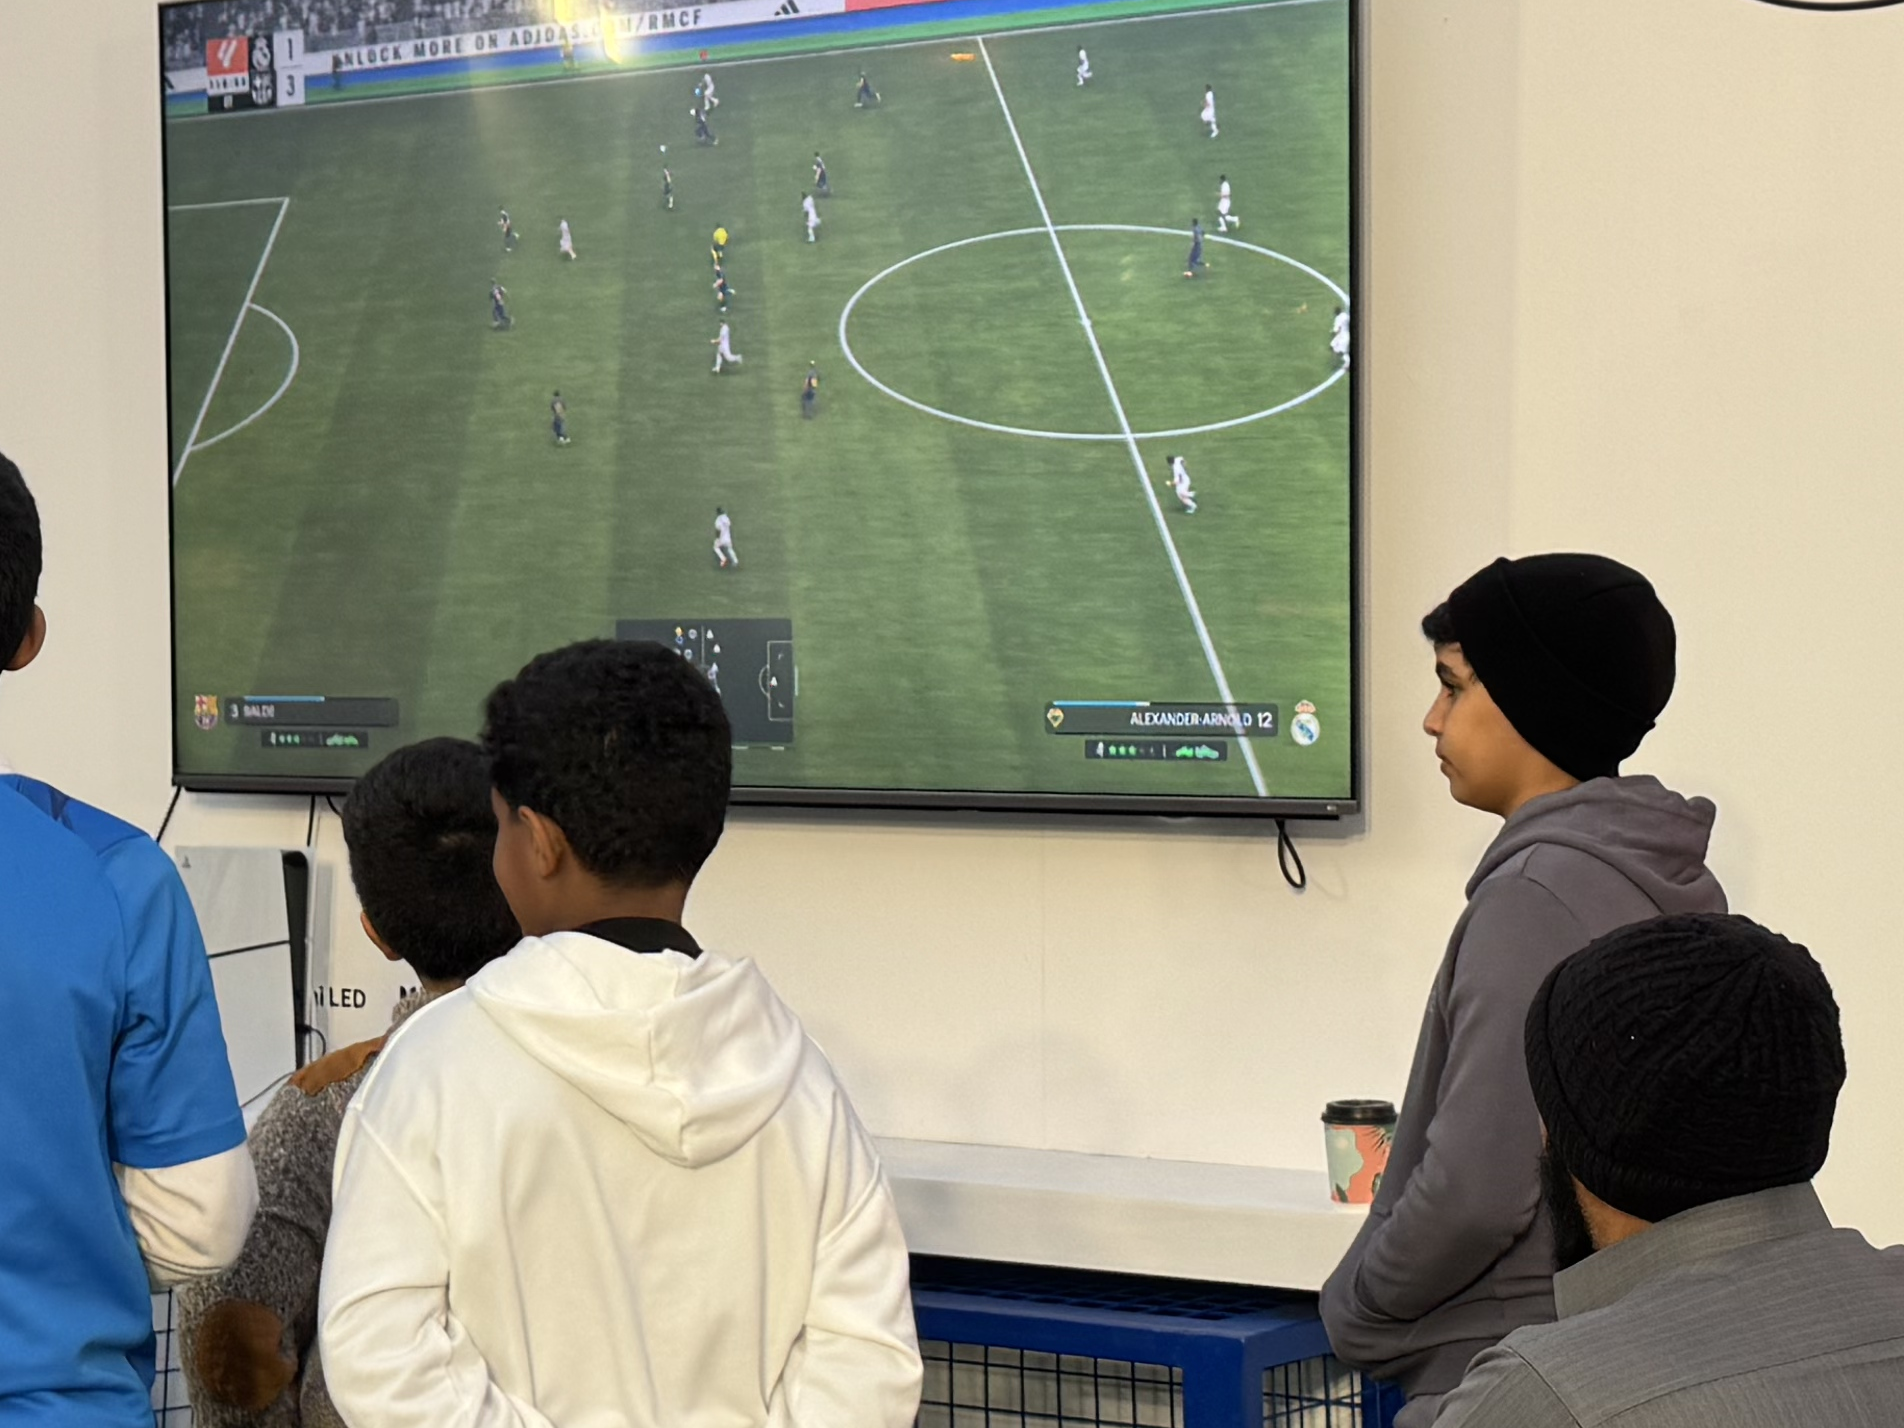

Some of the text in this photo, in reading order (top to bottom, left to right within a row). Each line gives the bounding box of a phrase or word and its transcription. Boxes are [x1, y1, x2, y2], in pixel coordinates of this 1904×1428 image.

[288, 38, 293, 60] 1
[286, 75, 295, 96] 3
[1257, 713, 1273, 728] 12
[329, 986, 366, 1008] LED
